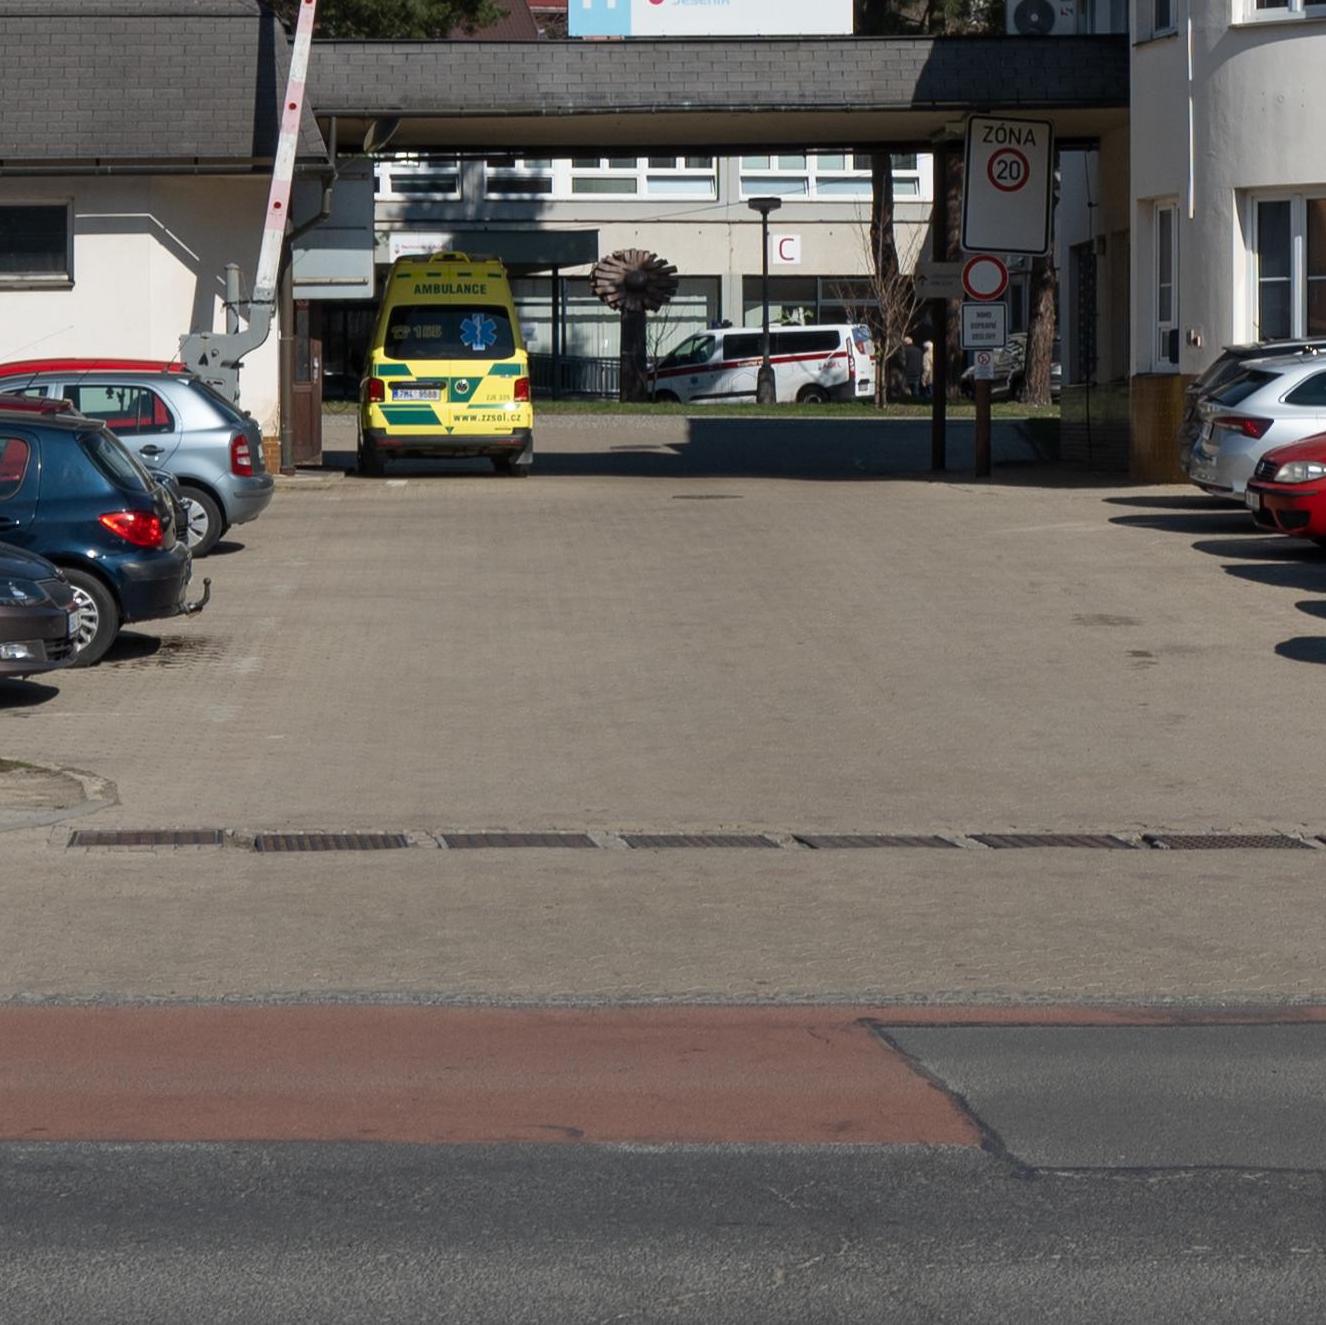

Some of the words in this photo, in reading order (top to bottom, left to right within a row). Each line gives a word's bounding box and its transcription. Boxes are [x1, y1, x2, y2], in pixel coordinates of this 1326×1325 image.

[982, 122, 1037, 147] ZÓNA
[996, 159, 1021, 180] 20
[779, 238, 795, 261] C
[414, 283, 487, 295] AMBULANCE
[453, 412, 521, 422] www.zzsol.cz
